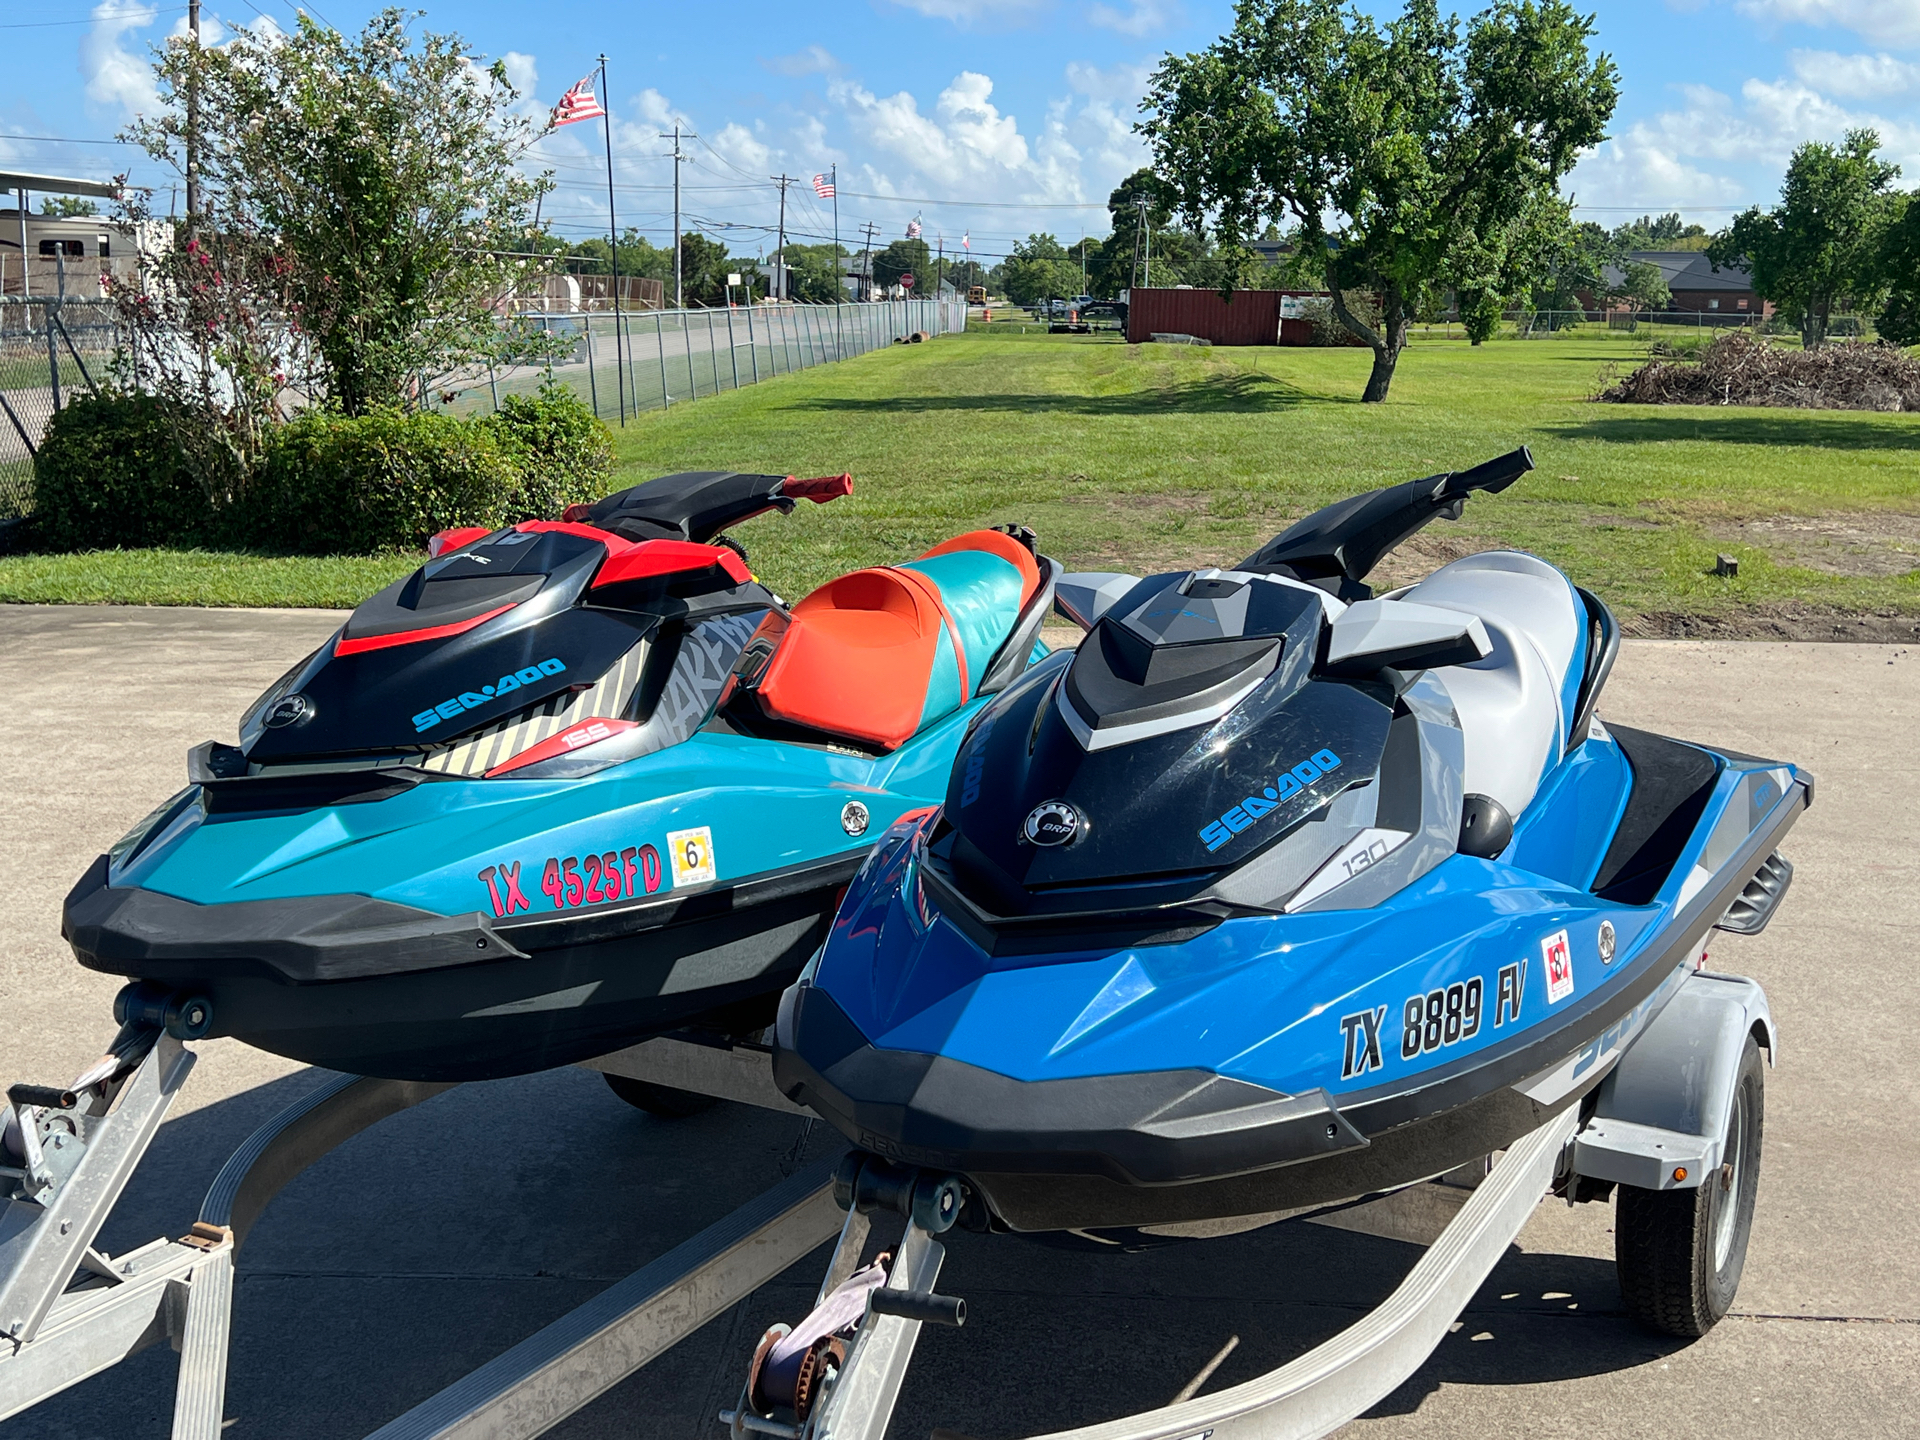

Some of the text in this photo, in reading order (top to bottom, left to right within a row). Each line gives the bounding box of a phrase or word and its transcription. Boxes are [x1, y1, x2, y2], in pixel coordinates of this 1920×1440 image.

[561, 722, 611, 748] 155
[1042, 823, 1071, 833] BRP
[685, 840, 699, 869] 6
[1342, 838, 1388, 877] 130
[478, 843, 662, 917] TX 4525FD
[1553, 946, 1563, 980] 8
[1340, 1004, 1388, 1080] TX
[1401, 975, 1483, 1060] 8889
[1493, 958, 1528, 1028] FV
